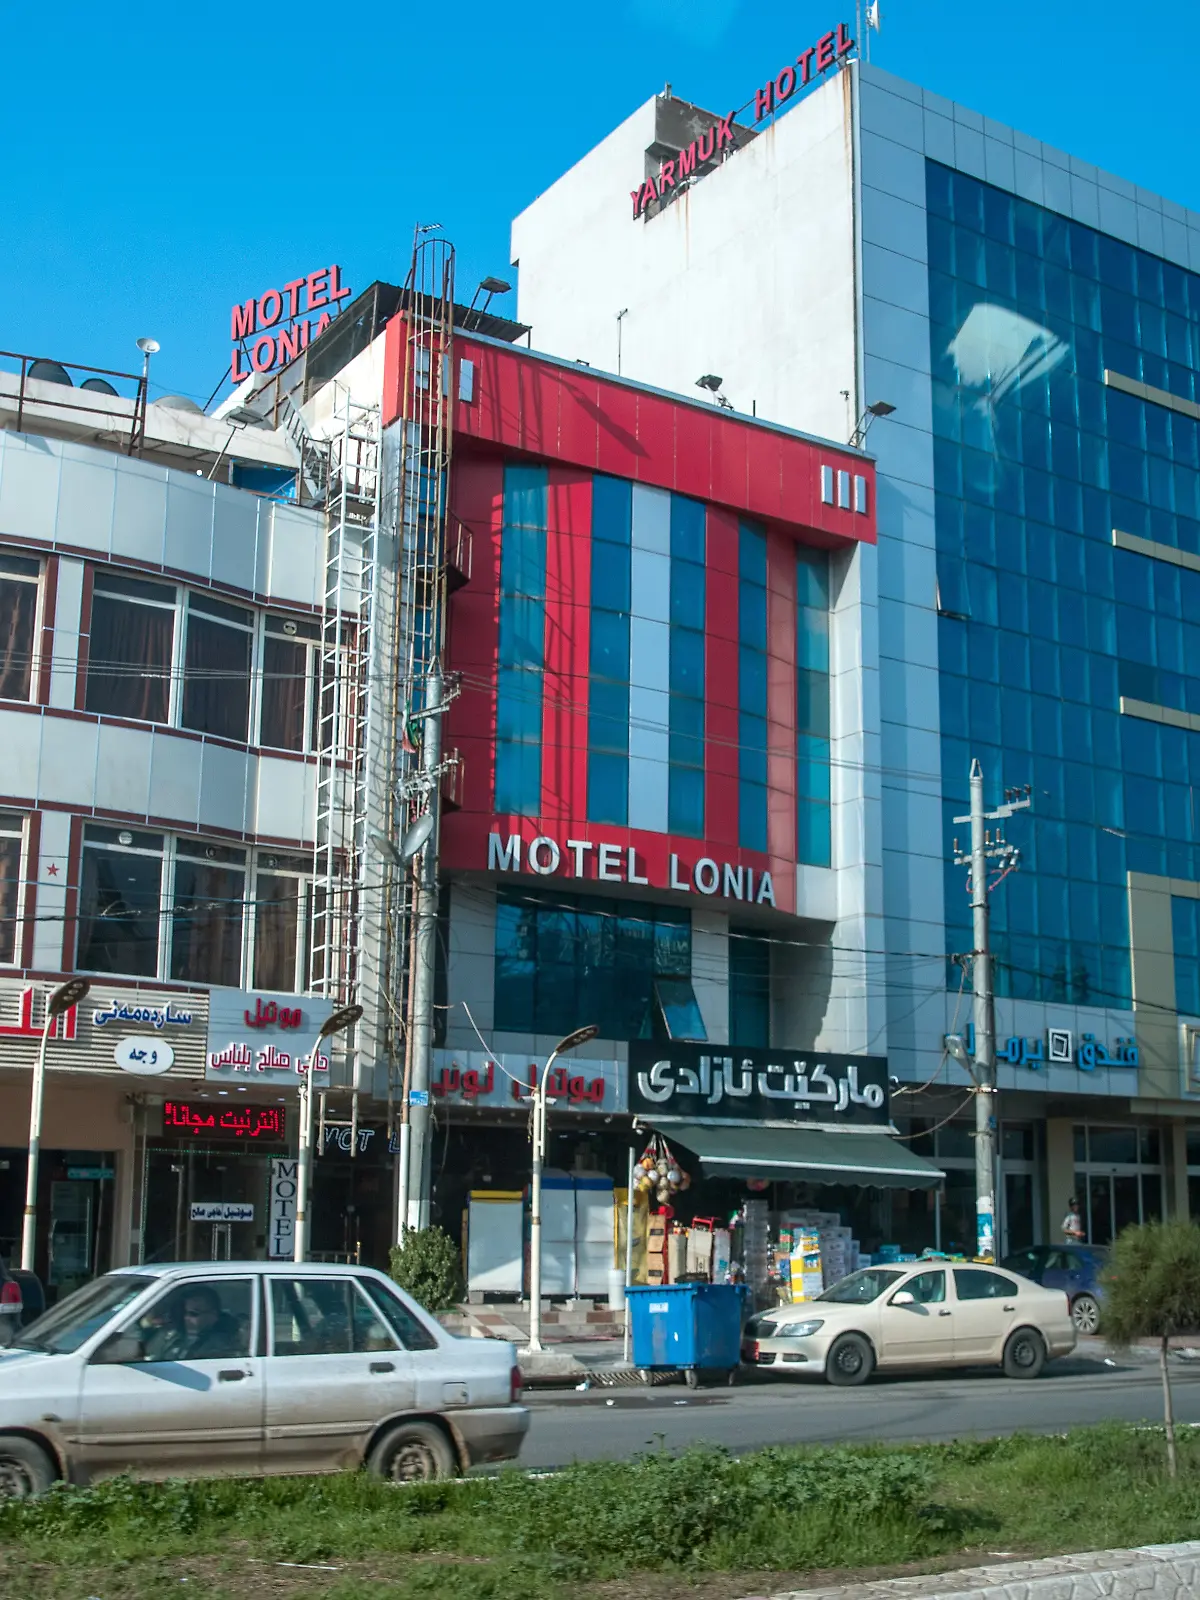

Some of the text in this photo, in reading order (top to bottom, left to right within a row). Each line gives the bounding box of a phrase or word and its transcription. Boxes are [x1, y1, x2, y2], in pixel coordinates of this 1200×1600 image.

[630, 23, 854, 215] YARMUK HOTEL
[231, 264, 351, 341] MOTEL
[231, 312, 332, 384] LONIA
[488, 832, 777, 908] MOTEL LONIA
[255, 1045, 291, 1071] صالح
[1077, 1033, 1139, 1071] فندق
[274, 1161, 299, 1256] MOTEL
